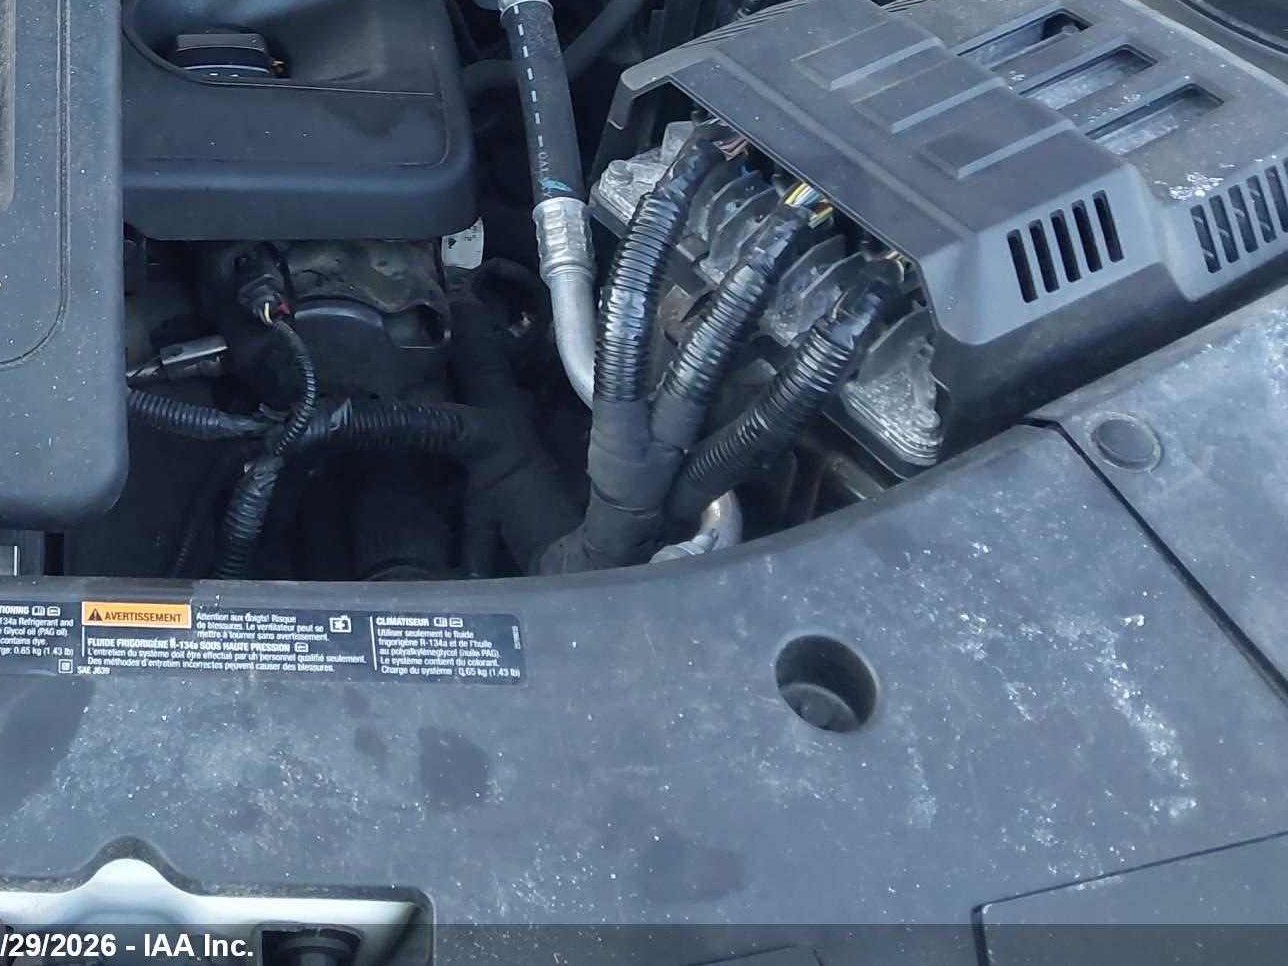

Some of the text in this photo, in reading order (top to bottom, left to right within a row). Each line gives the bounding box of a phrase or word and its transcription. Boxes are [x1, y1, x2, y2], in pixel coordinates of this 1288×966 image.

[105, 612, 182, 622] AVERTISSEMENT
[272, 615, 296, 624] Risque
[376, 617, 429, 626] CLIMATISEUR
[19, 618, 58, 627] Refrigerant
[60, 619, 73, 627] and
[4, 627, 25, 636] Glycol
[27, 627, 36, 635] oil
[38, 628, 54, 636] (PAG
[297, 624, 313, 633] peut
[197, 630, 221, 639] mettre
[378, 629, 474, 639] Utiliser seulement le fluide
[88, 638, 115, 647] FLUIDE
[170, 637, 198, 649] R-134a
[200, 642, 221, 650] SOUS
[223, 642, 249, 650] HAUTE
[251, 643, 290, 651] PRESSION
[420, 639, 447, 647] R-134a
[449, 639, 457, 647] et
[459, 639, 468, 648] de
[32, 647, 41, 656] kg
[171, 650, 185, 658] doit
[260, 654, 296, 662] personnel
[88, 657, 102, 665] Des
[183, 661, 223, 669] incorrectes
[225, 662, 254, 671] peuvent
[256, 663, 280, 671] causer
[380, 656, 390, 664] Le
[424, 658, 454, 666] contient
[456, 658, 466, 666] du
[77, 666, 91, 674] SAE
[381, 666, 408, 675] Charge
[410, 666, 420, 674] du
[478, 668, 487, 677] kg
